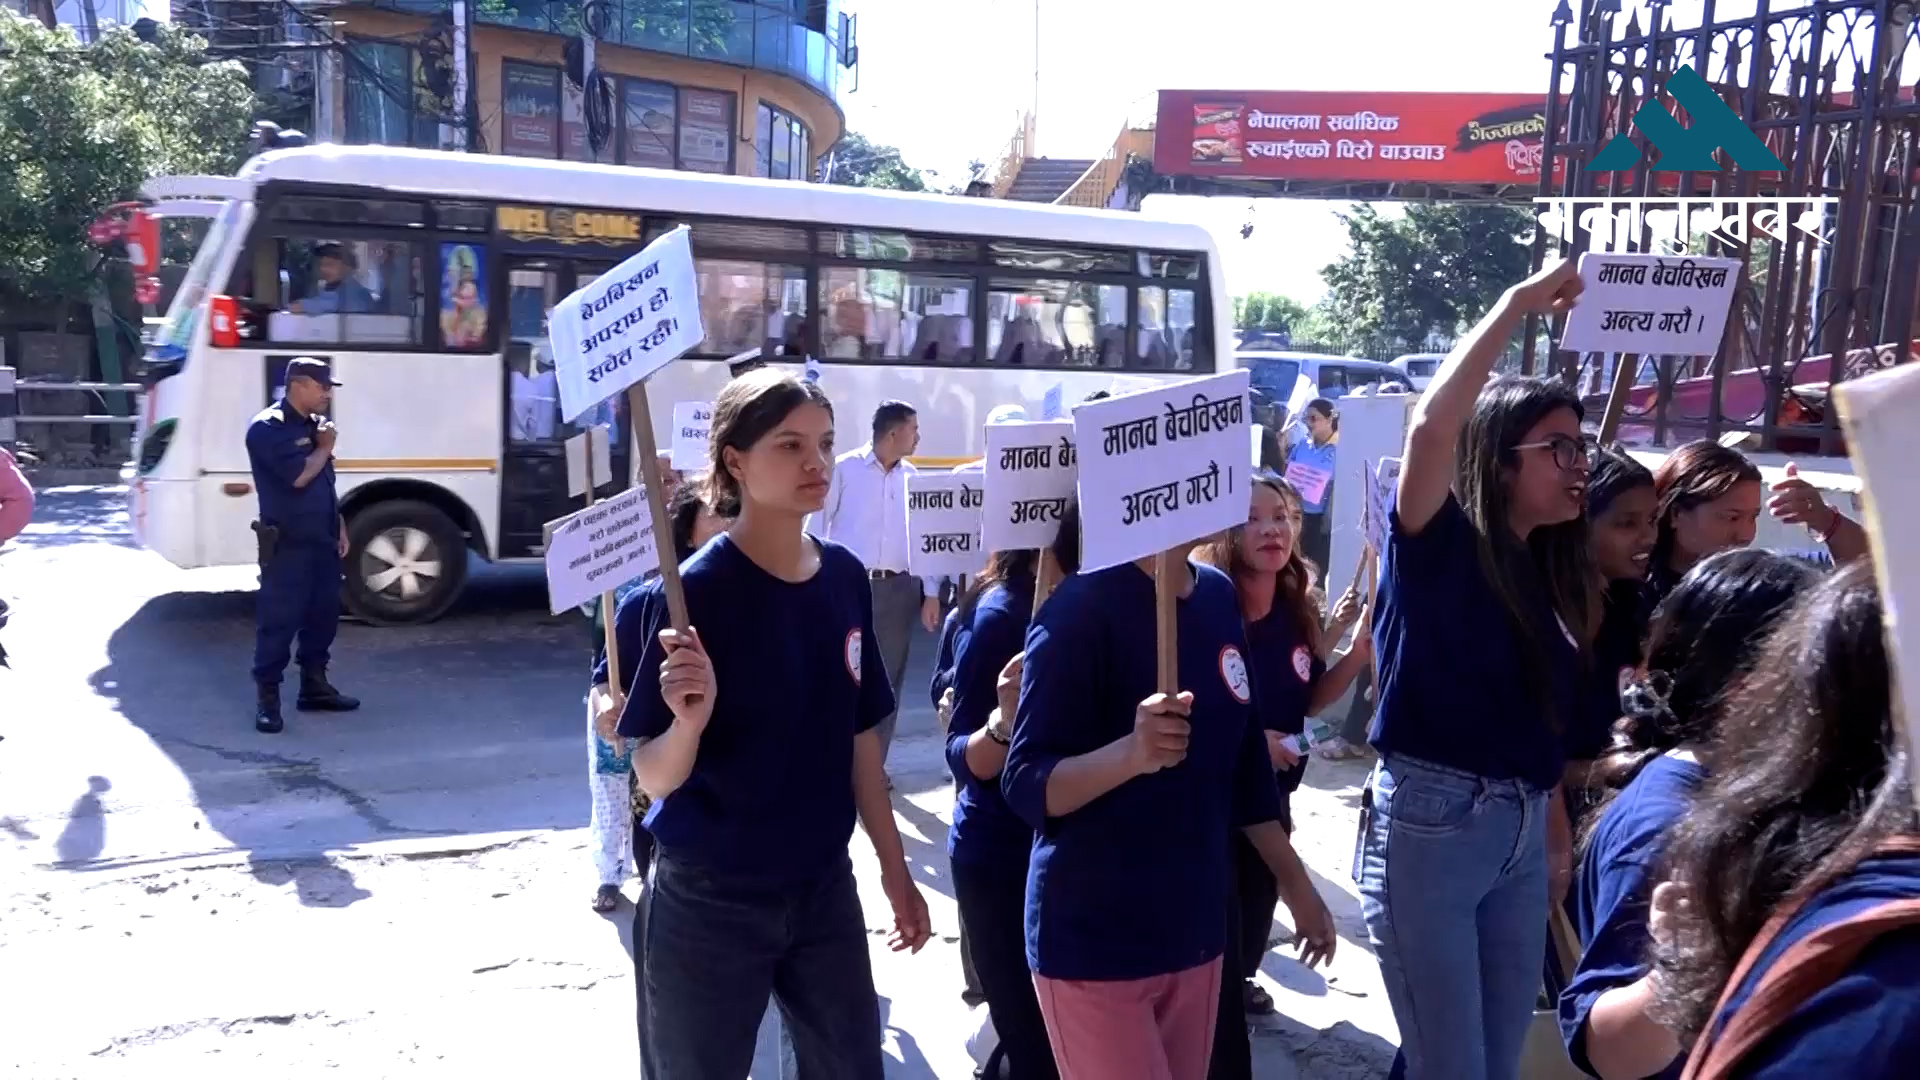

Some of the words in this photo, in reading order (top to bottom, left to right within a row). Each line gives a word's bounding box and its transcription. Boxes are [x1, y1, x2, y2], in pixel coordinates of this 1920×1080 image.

[1247, 109, 1323, 131] नेपालमा
[1326, 111, 1400, 132] सर्वाधिक
[1336, 139, 1375, 161] पिरो
[1379, 144, 1447, 162] चाउचाउ
[1597, 262, 1649, 286] मानव
[580, 304, 644, 354] अपराध
[1600, 310, 1654, 333] अन्त्य
[587, 345, 633, 383] सचेत
[1102, 415, 1159, 457] मानव
[1000, 444, 1053, 472] मानव
[908, 489, 954, 510] मानव
[959, 483, 984, 509] बेच
[1121, 480, 1180, 526] अन्त्य
[1010, 497, 1068, 525] अन्त्य
[920, 533, 972, 554] अन्त्य
